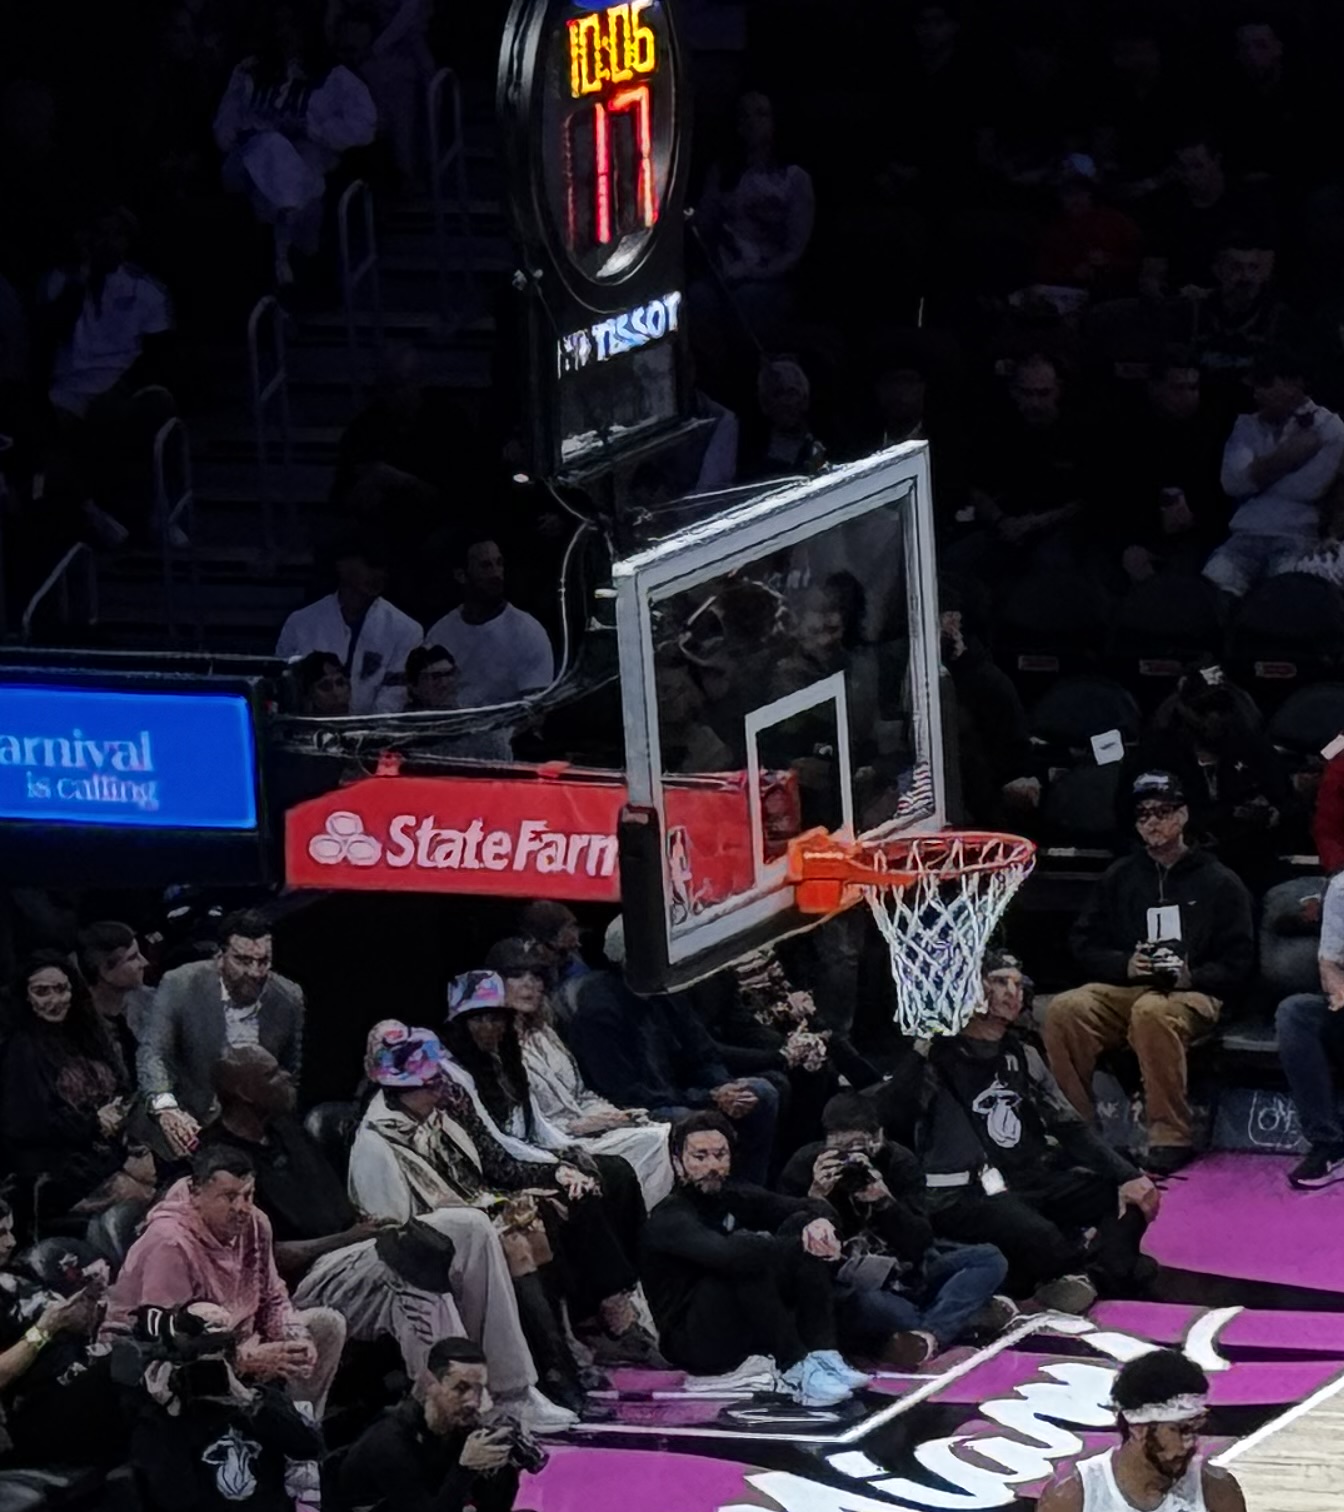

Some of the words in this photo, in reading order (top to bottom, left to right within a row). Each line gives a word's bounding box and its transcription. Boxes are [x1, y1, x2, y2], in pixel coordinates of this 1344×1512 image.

[567, 1, 656, 98] 10:06
[593, 85, 658, 244] 17
[591, 290, 681, 361] TISSOT
[0, 728, 154, 771] arnival
[26, 770, 51, 798] is
[57, 773, 159, 811] calling
